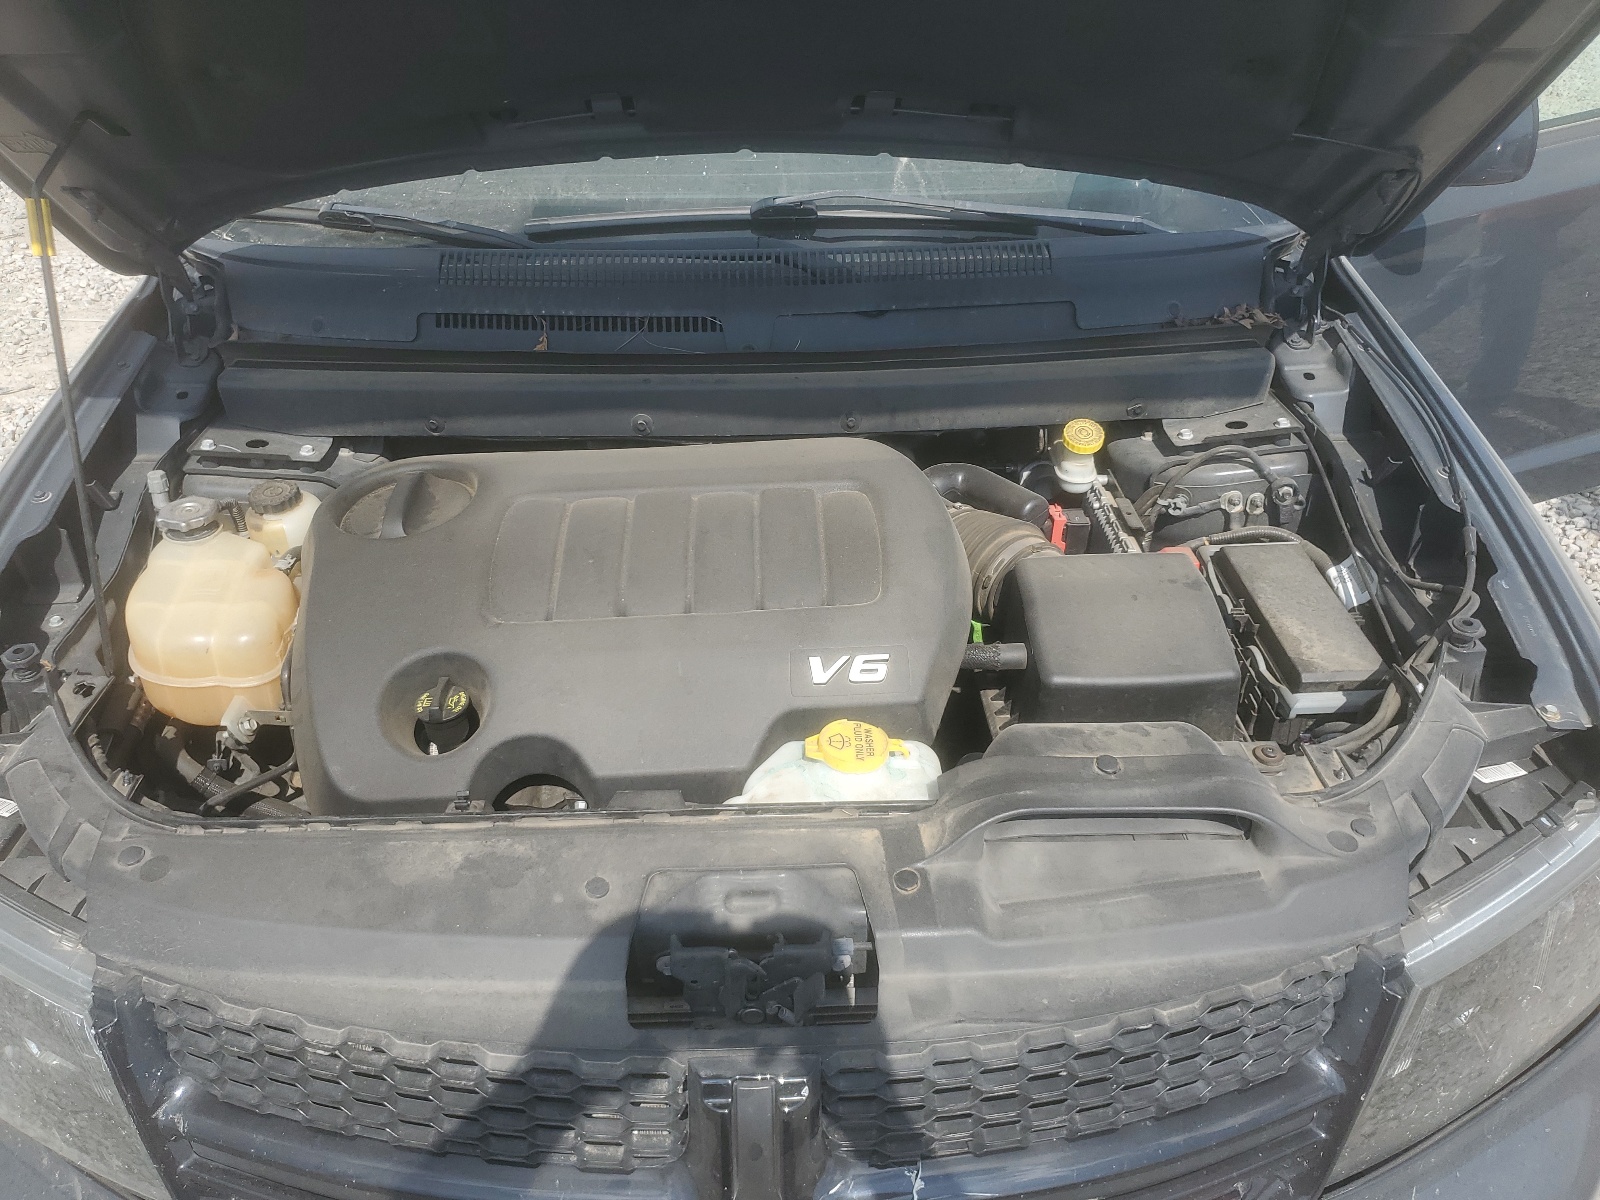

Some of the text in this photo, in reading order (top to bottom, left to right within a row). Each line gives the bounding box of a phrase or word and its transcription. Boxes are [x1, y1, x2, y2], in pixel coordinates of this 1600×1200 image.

[808, 653, 890, 686] V6
[853, 723, 865, 761] FLUID ONLY
[864, 728, 875, 757] WASHER
